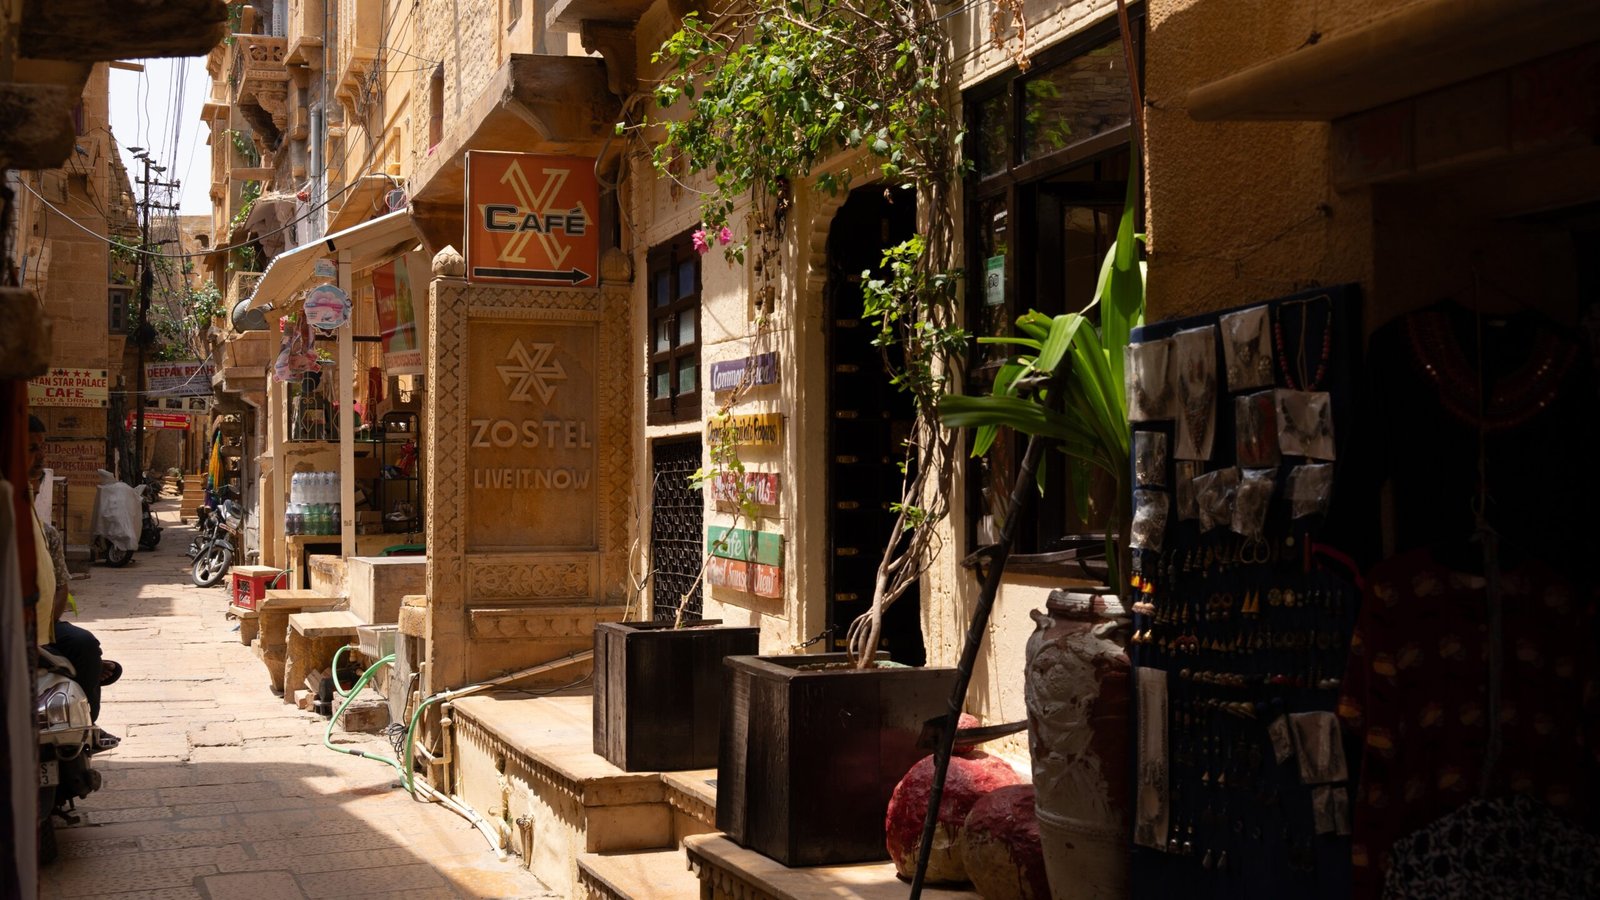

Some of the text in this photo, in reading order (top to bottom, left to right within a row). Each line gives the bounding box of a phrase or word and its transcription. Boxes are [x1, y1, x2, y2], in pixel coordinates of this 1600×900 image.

[484, 204, 587, 236] CAFÉ
[53, 377, 74, 387] STAR
[76, 378, 107, 388] PALACE
[147, 366, 182, 378] DEEPAK
[45, 387, 84, 398] CAFE
[470, 418, 593, 449] ZOSTEL
[717, 529, 743, 559] Cafe
